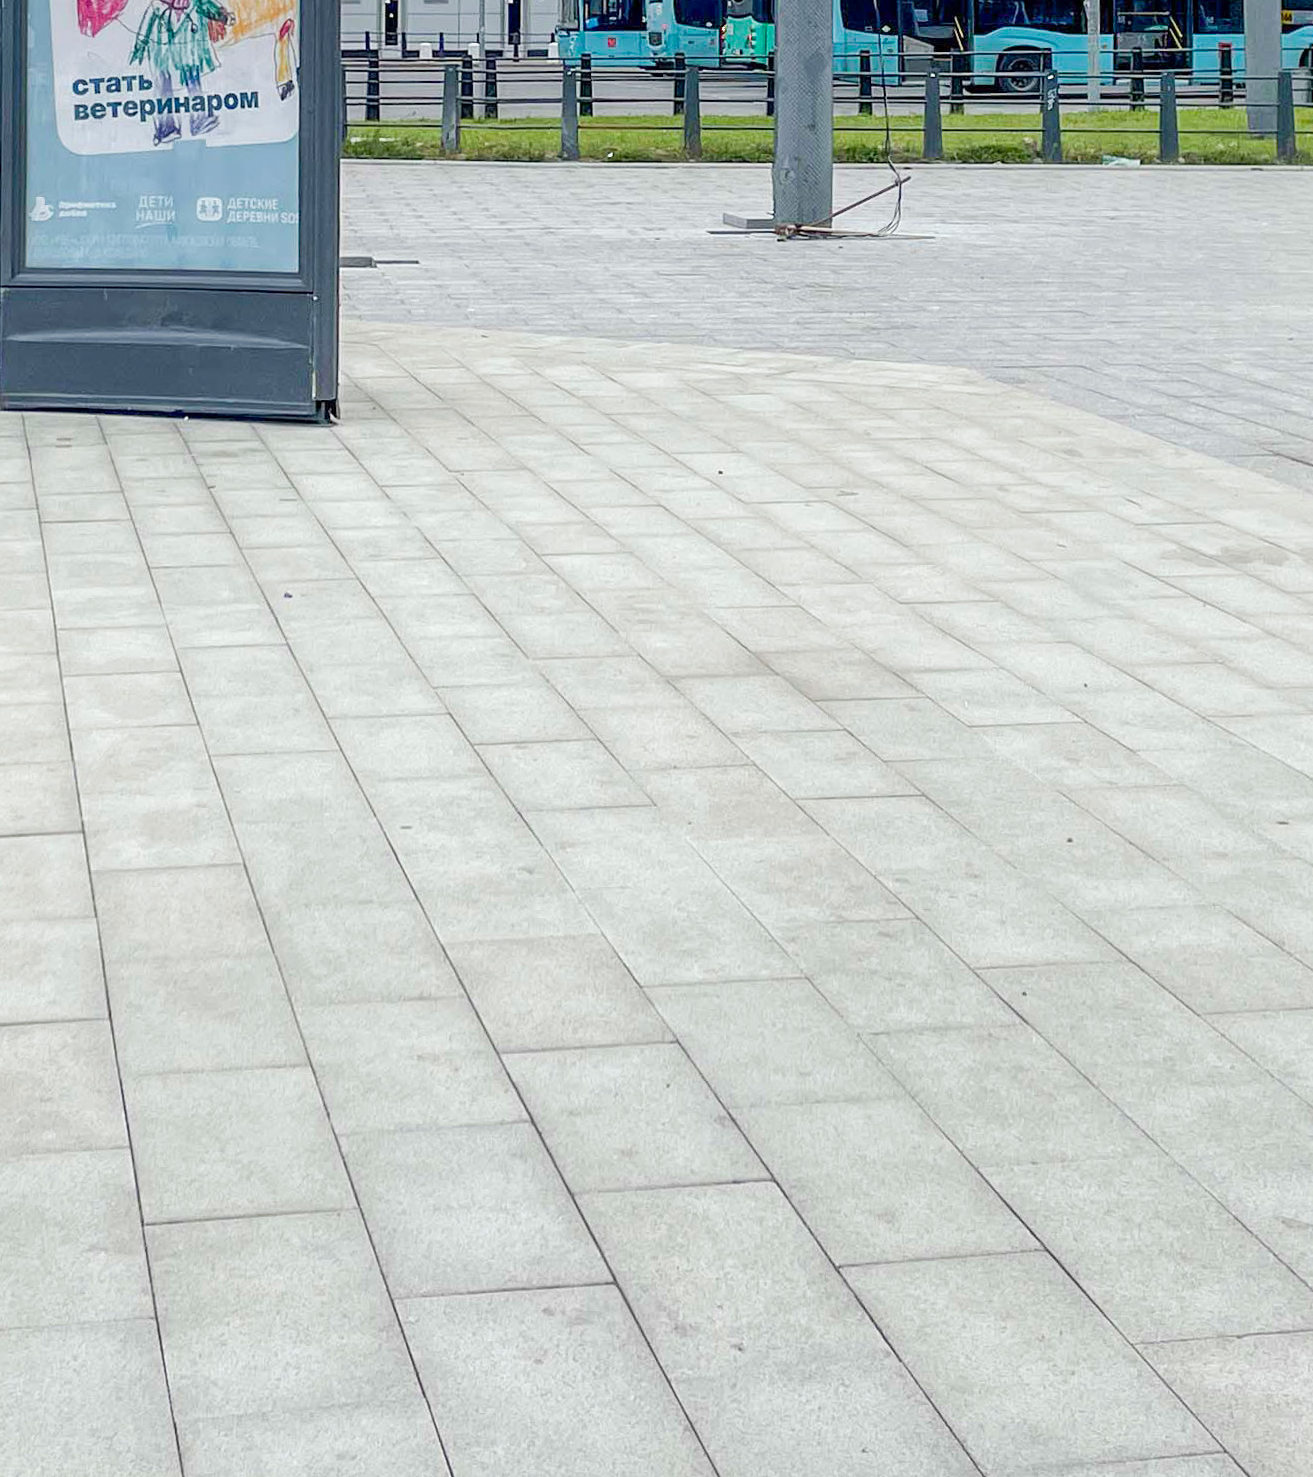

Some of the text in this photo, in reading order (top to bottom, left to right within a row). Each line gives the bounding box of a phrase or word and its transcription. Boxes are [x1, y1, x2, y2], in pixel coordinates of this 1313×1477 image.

[72, 74, 154, 96] стать
[74, 91, 259, 122] ветеринаром
[138, 195, 175, 210] ДЕТИ
[227, 197, 280, 210] ДЕТСКИЕ
[135, 209, 176, 223] НАШИ
[227, 210, 280, 224] ДЕРЕВНИ
